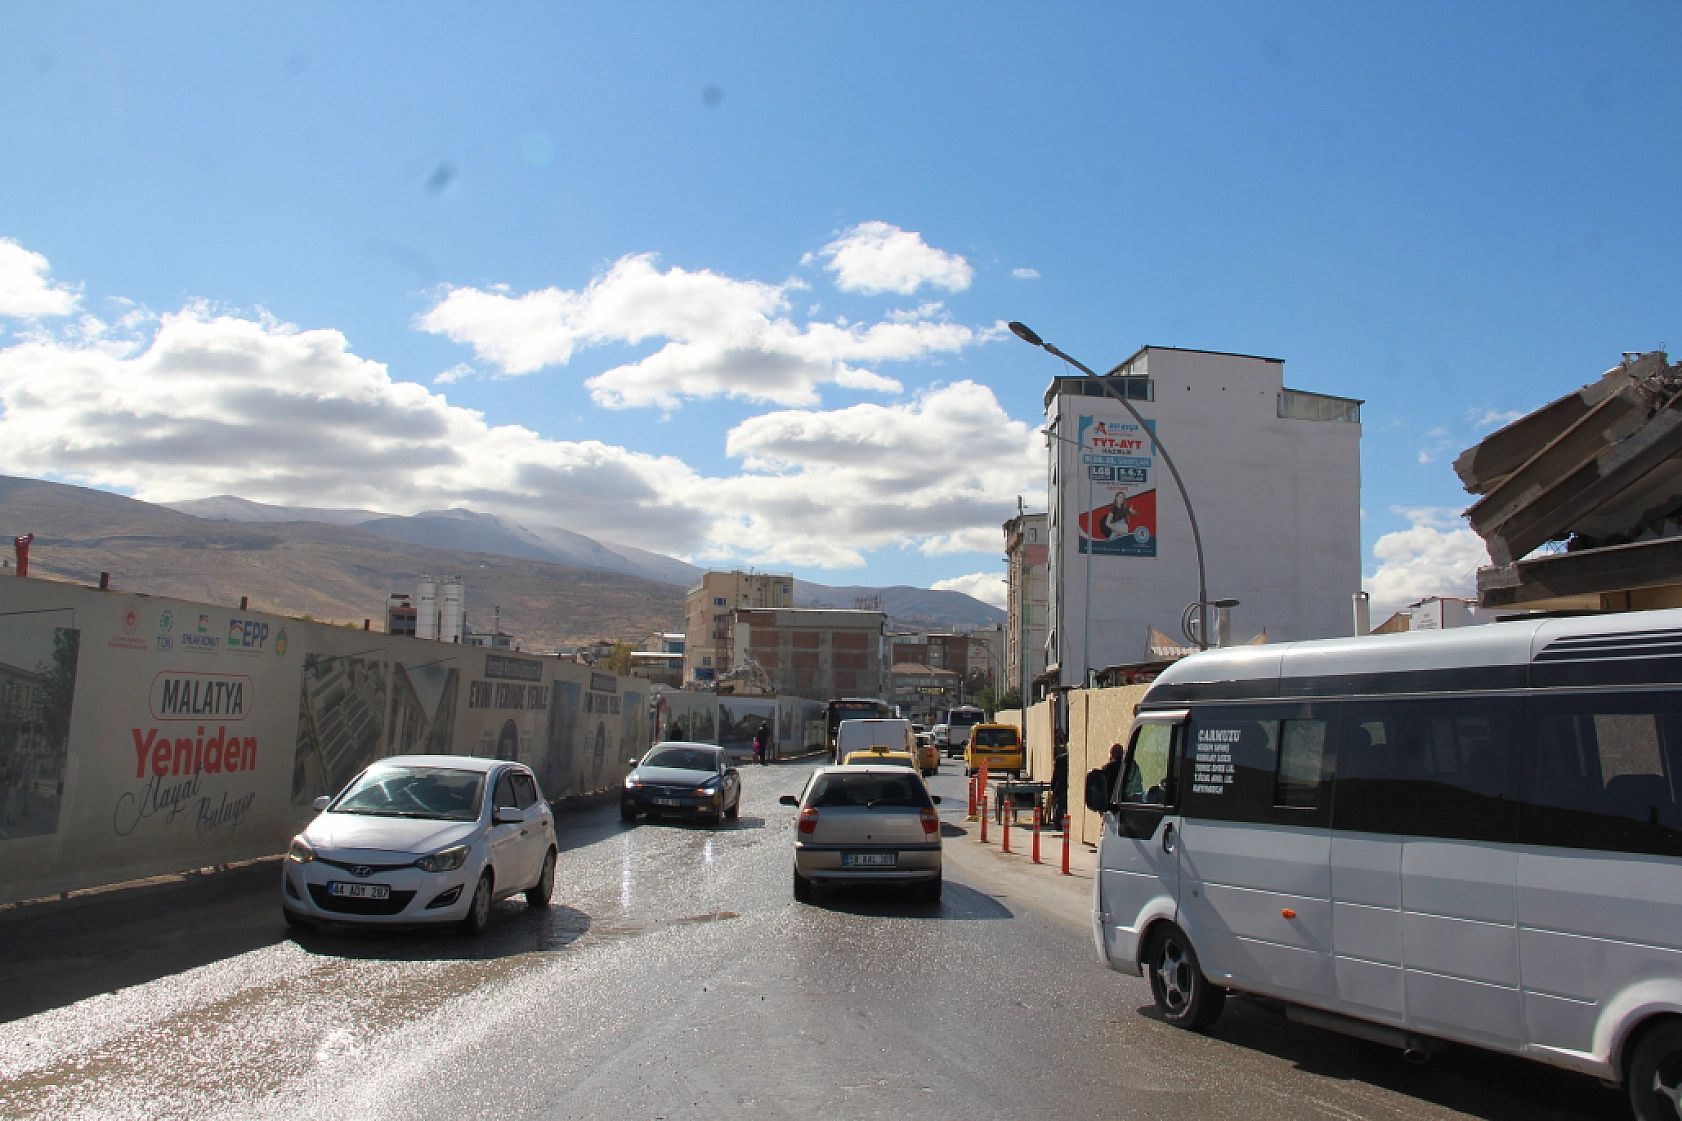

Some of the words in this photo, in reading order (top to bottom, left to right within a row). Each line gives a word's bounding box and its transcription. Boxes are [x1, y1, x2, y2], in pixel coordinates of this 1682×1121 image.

[1092, 437, 1142, 449] TYT-AYT
[161, 679, 243, 715] MALATYA
[132, 725, 258, 778] Yeniden
[334, 883, 343, 894] 44
